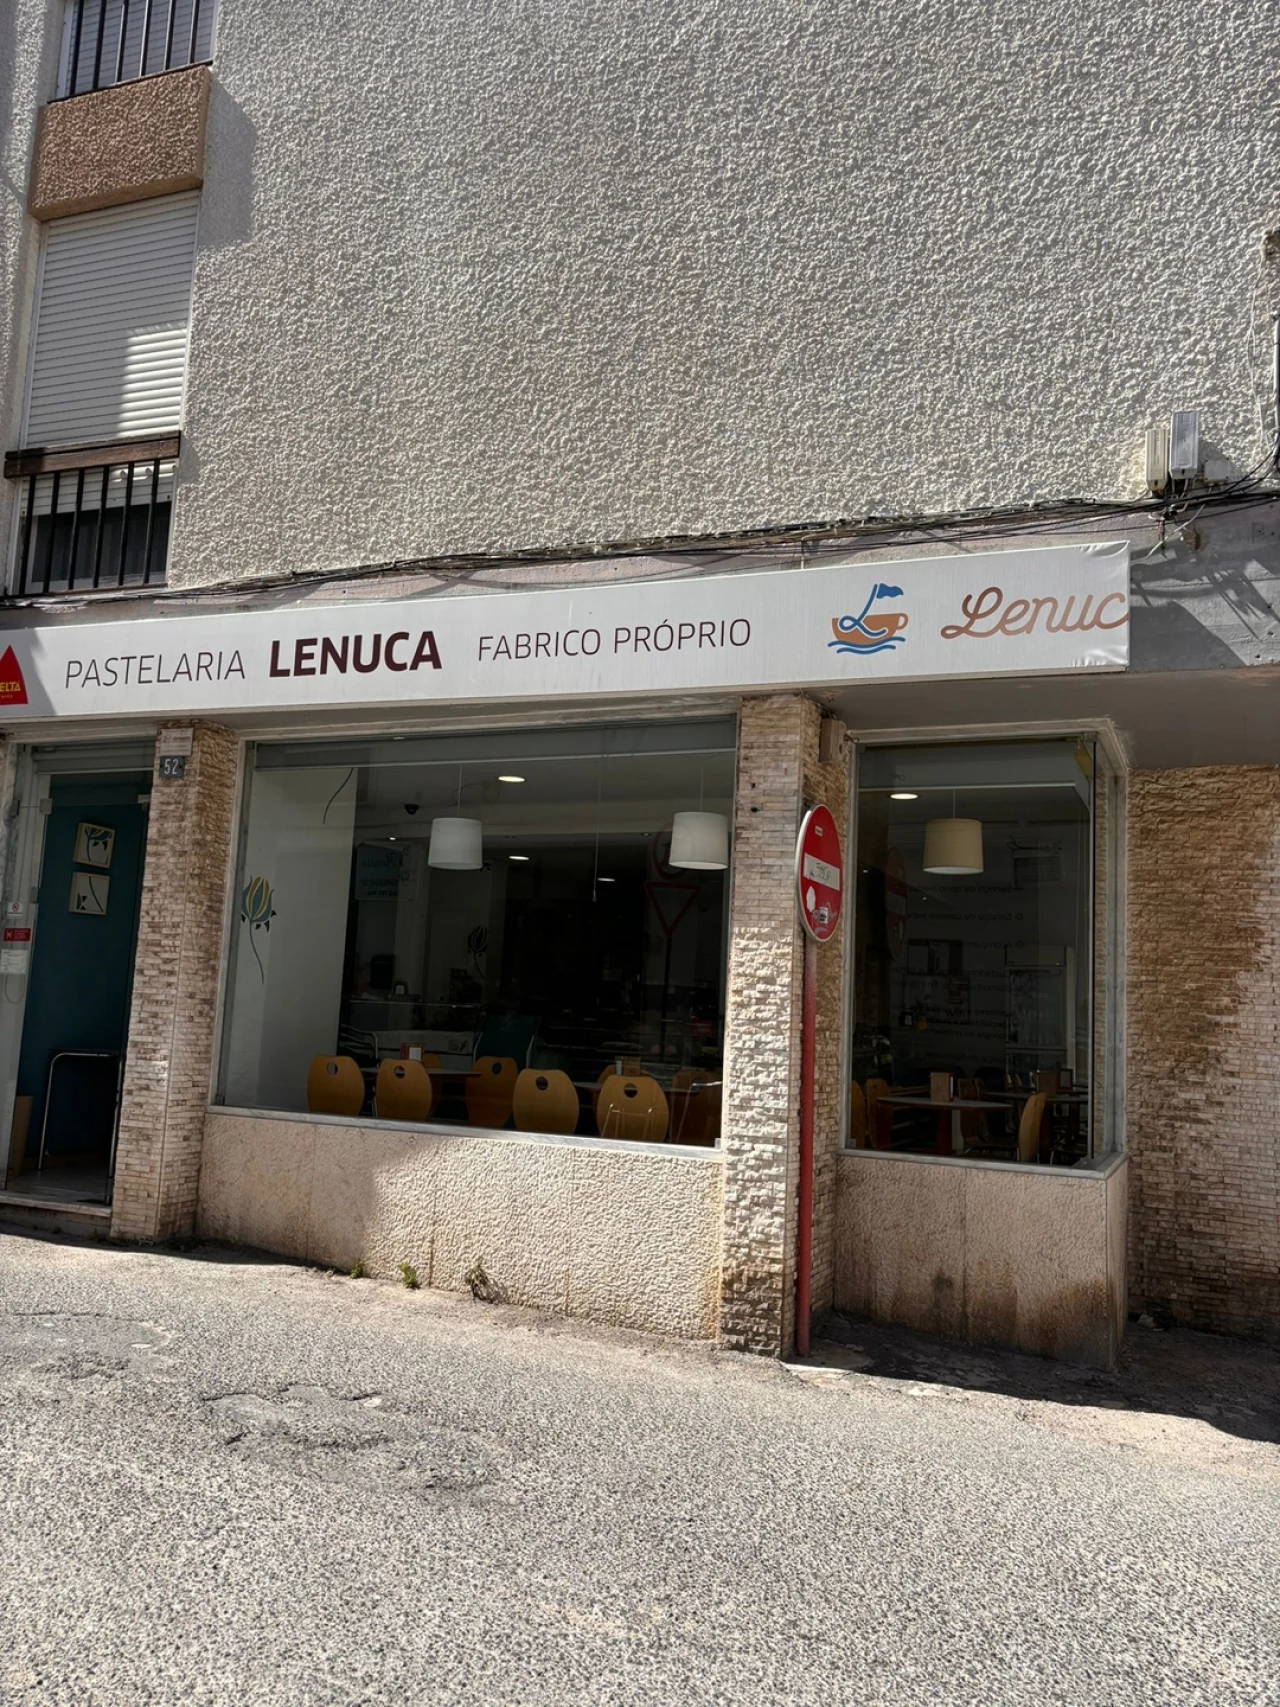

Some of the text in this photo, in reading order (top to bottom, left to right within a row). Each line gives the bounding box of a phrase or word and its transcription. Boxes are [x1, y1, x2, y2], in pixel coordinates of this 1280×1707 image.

[65, 630, 443, 689] PASTELARIA LENUCA
[478, 618, 752, 662] FABRICO PRÓPRIO
[164, 758, 179, 775] 52
